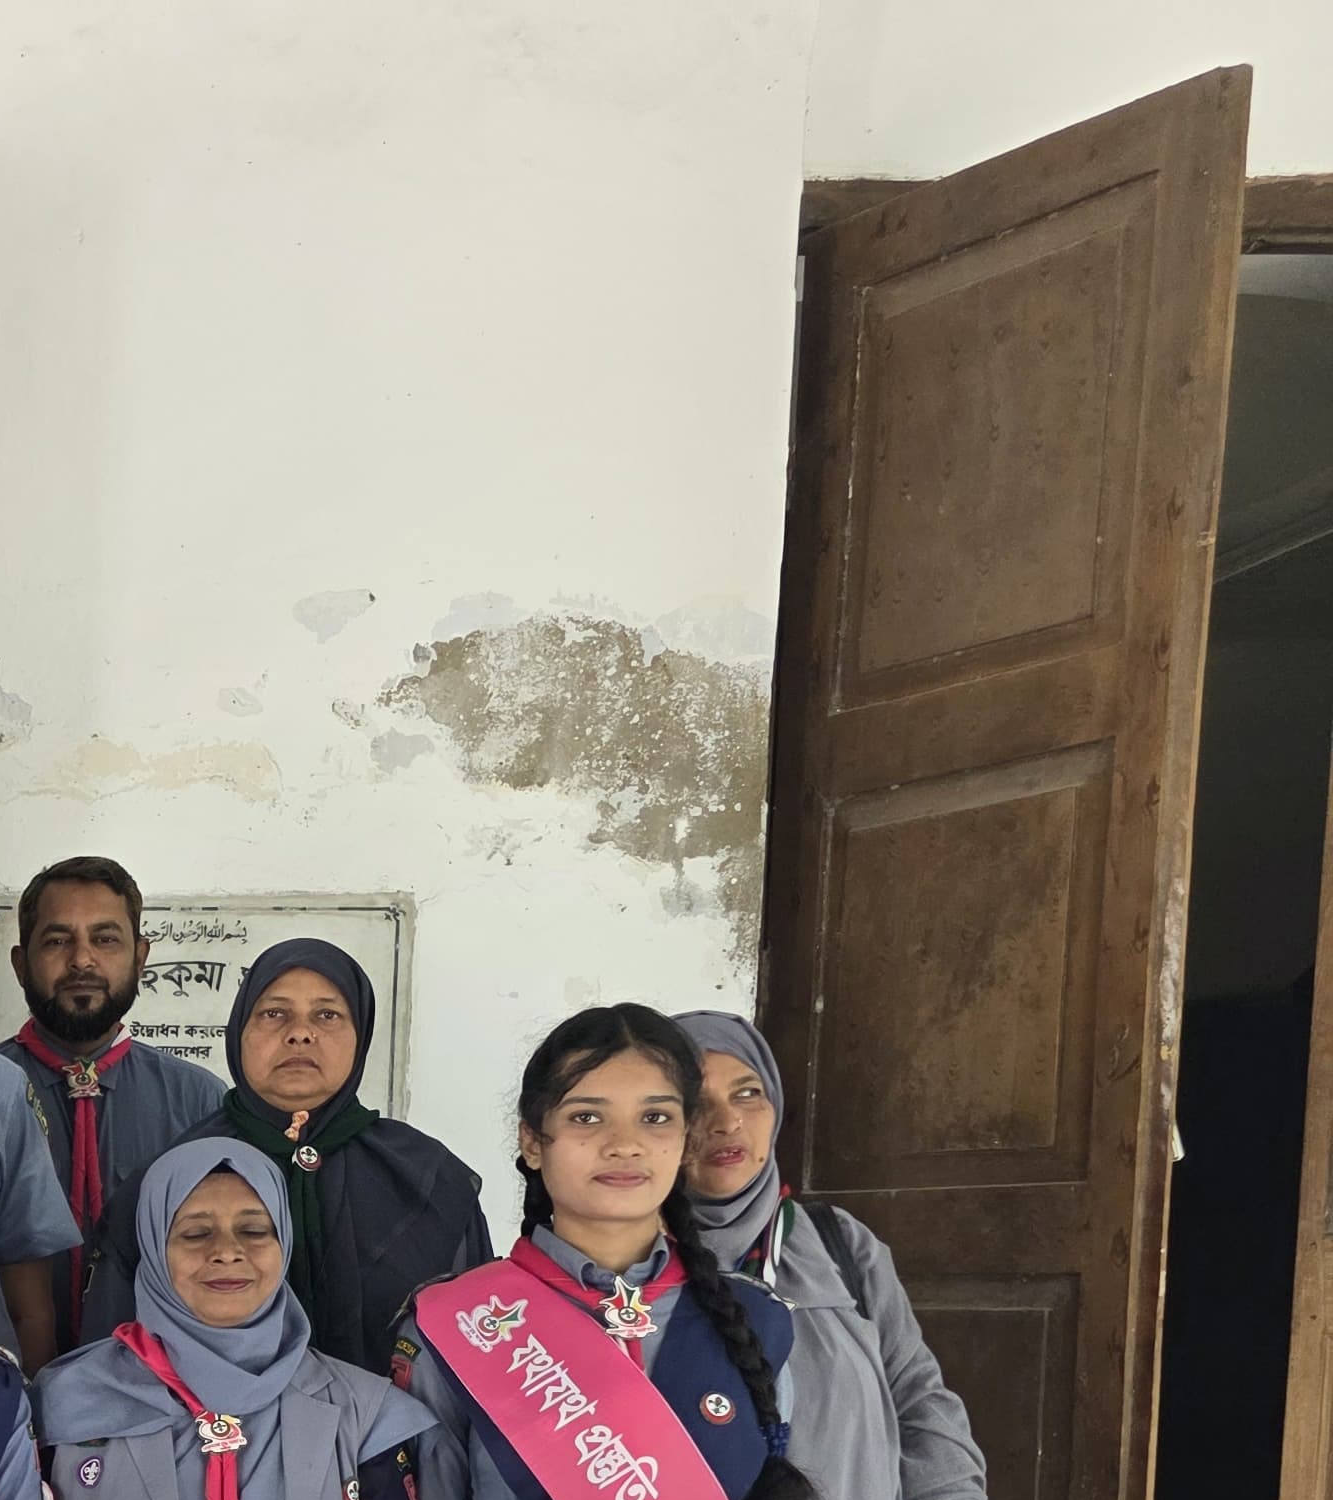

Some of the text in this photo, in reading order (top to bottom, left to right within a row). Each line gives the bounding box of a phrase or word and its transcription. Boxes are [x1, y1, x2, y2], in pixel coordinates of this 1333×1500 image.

[141, 961, 227, 998] হকুমা
[130, 1021, 180, 1038] উদ্বোধন
[506, 1333, 599, 1432] যথাযথ
